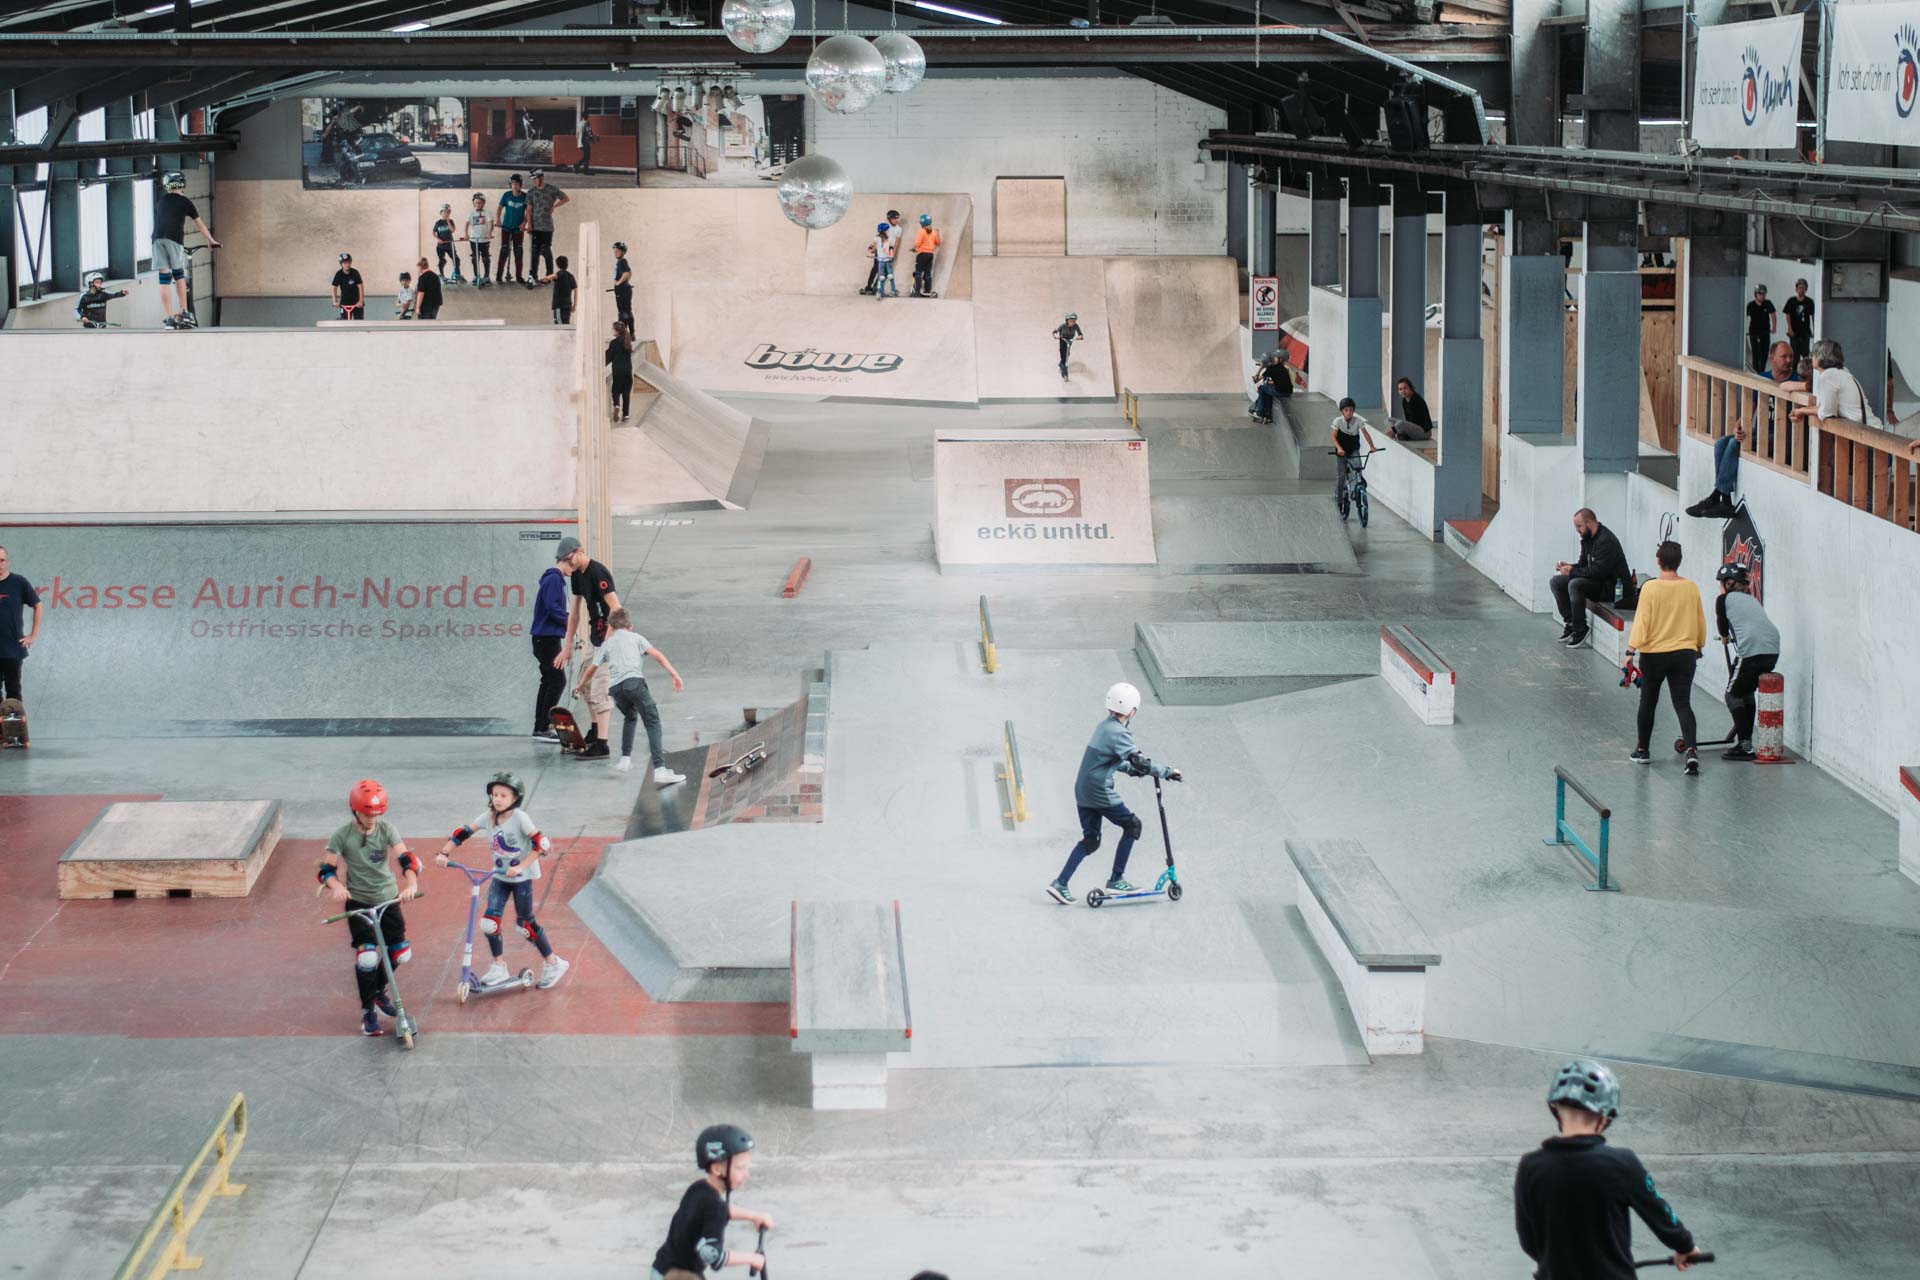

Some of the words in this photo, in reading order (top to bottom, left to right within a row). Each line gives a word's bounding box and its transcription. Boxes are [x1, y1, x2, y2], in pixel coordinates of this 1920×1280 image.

[1837, 62, 1849, 91] Ich
[1850, 63, 1862, 91] seh
[1863, 63, 1882, 91] dich
[1882, 63, 1891, 91] in
[744, 343, 904, 373] böwe
[1042, 523, 1115, 540] unltd.
[33, 575, 176, 609] rkasse
[191, 575, 526, 609] Aurich-Norden
[190, 618, 373, 639] Ostfriesische
[381, 618, 524, 641] Sparkasse
